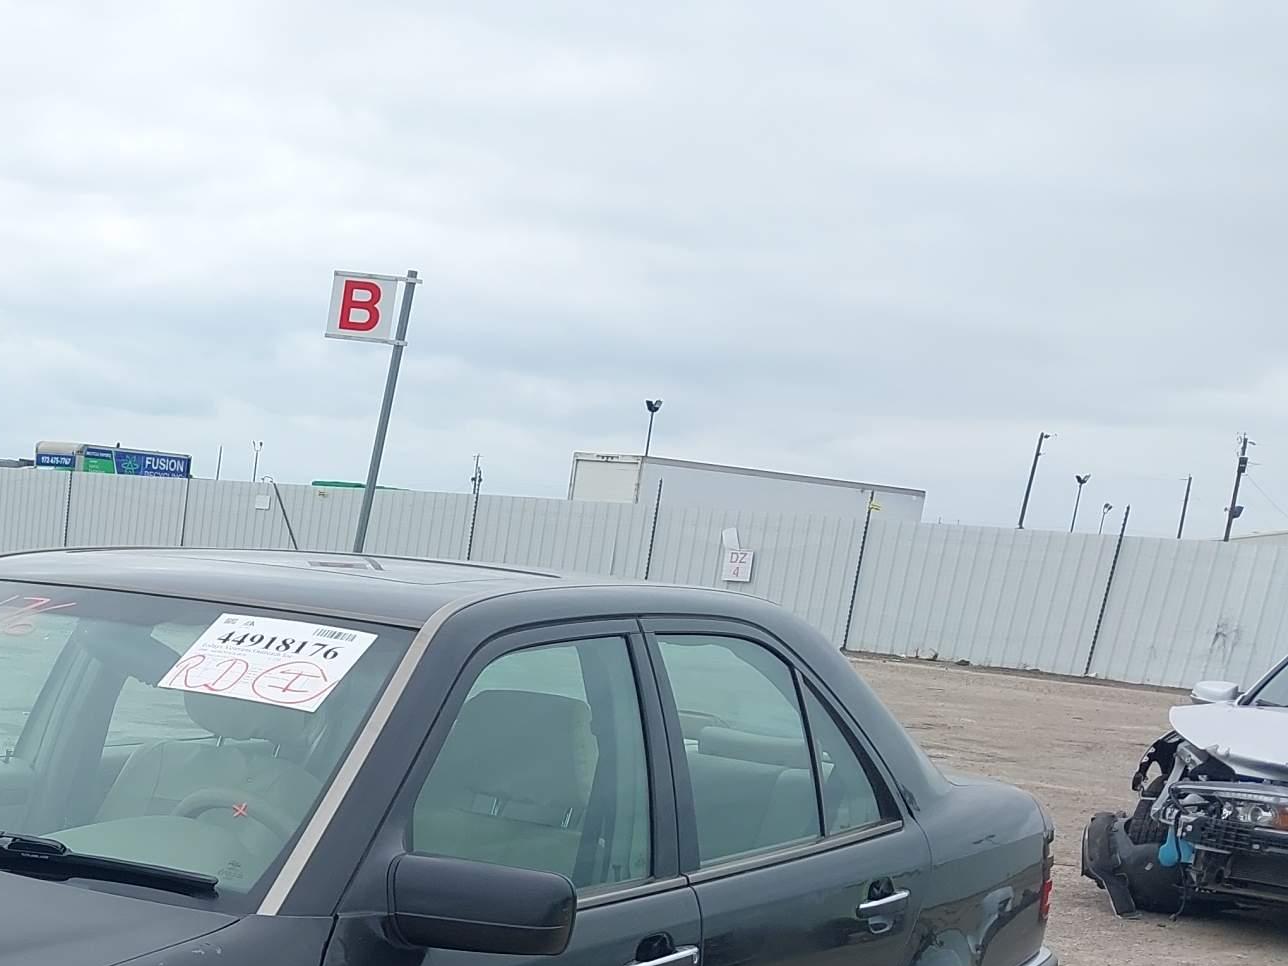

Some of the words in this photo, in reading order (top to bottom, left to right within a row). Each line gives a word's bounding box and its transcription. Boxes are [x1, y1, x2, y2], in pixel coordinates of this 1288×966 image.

[339, 279, 382, 331] B
[145, 456, 184, 473] FUSION
[729, 552, 747, 563] DZ
[216, 631, 345, 661] 44918176
